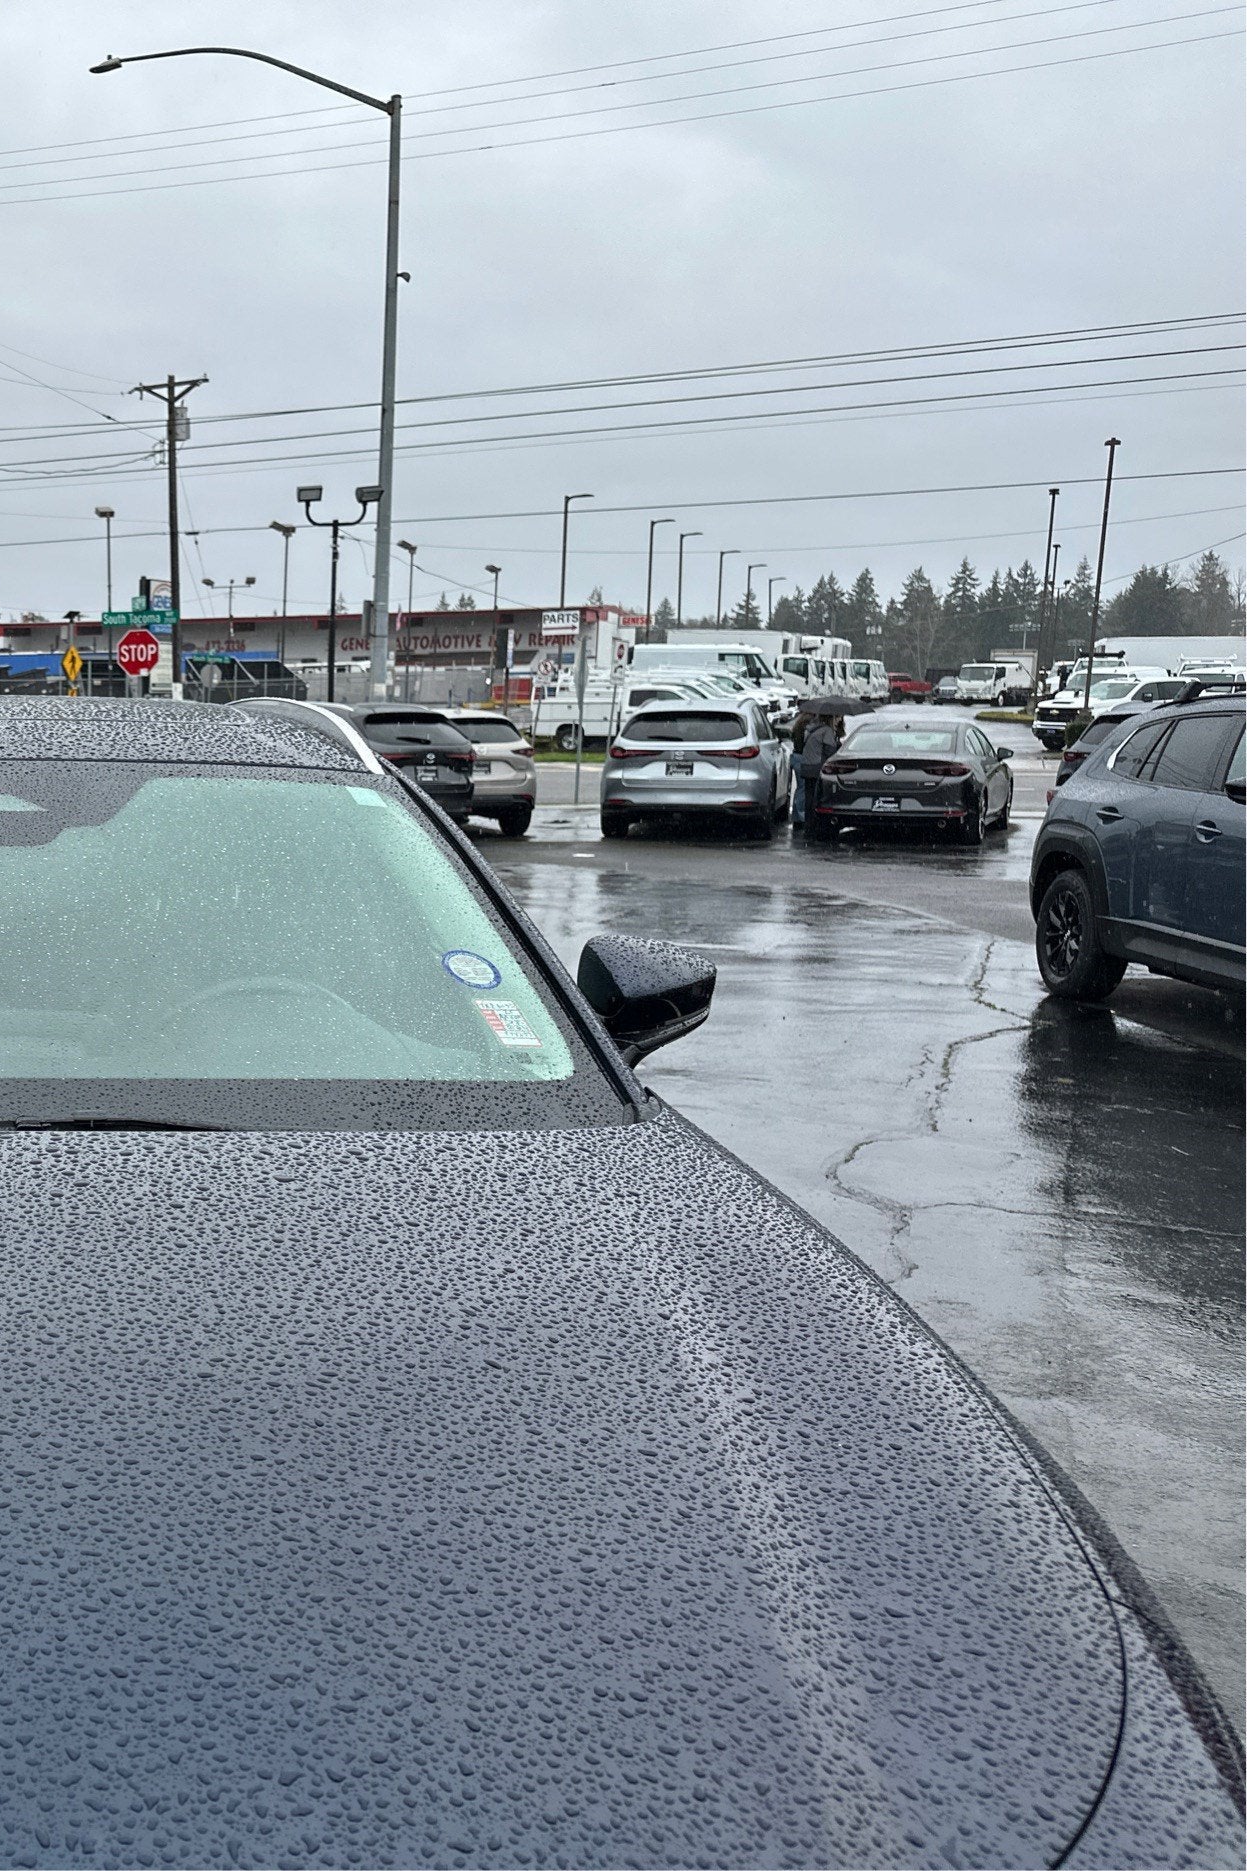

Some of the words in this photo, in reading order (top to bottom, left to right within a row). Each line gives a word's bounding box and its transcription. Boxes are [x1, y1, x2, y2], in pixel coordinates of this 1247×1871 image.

[103, 614, 127, 625] South
[129, 613, 161, 624] Tacoma
[543, 612, 579, 624] PARTS
[341, 637, 370, 651] GENE
[395, 634, 482, 651] AUTOMOTIVE
[528, 633, 576, 647] REPAIR
[120, 644, 157, 662] STOP
